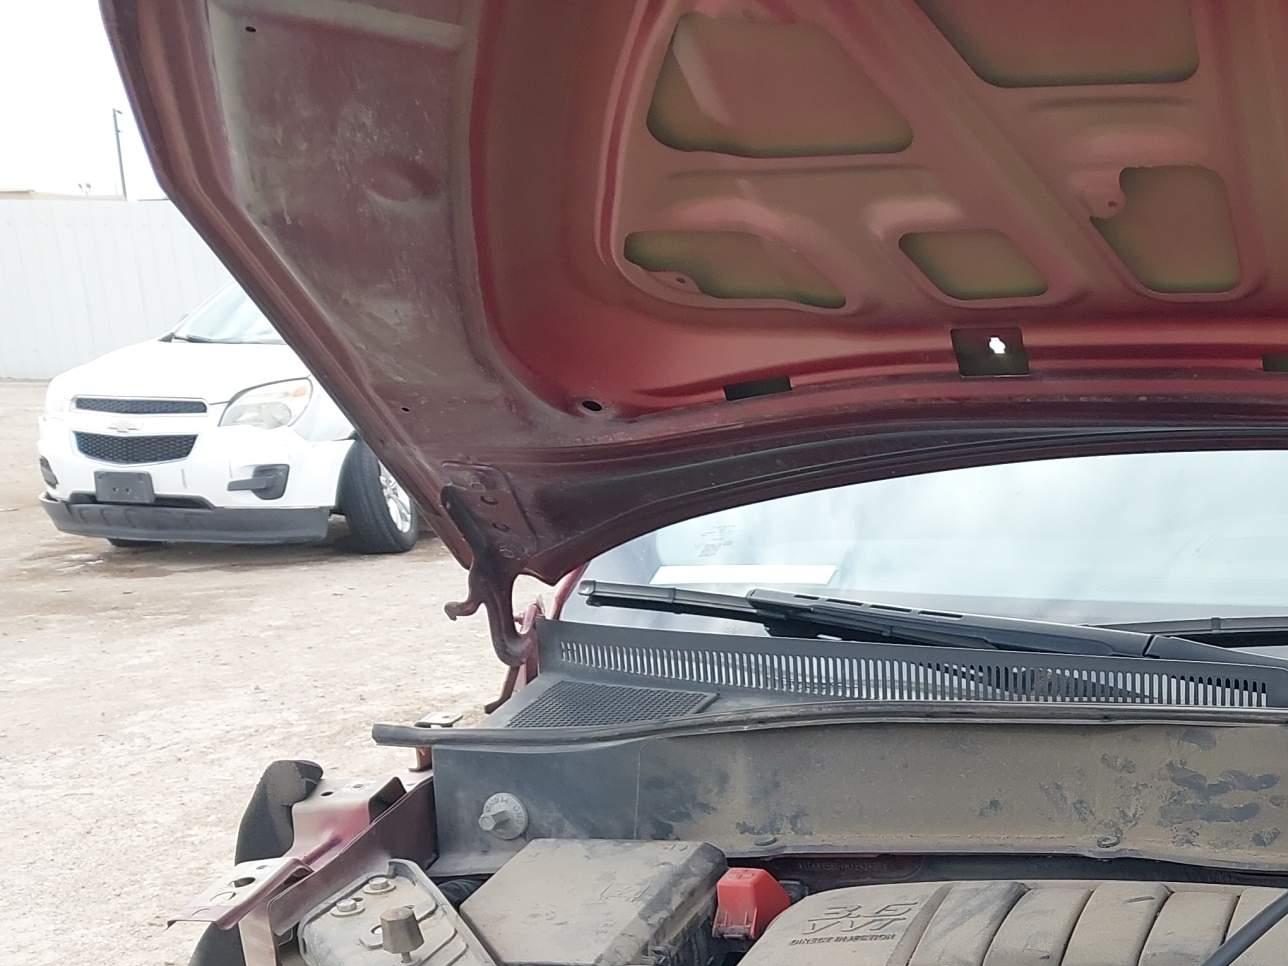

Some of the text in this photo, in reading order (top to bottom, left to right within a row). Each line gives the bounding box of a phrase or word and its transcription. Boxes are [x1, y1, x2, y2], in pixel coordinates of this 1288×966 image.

[808, 902, 918, 922] 3.6
[802, 918, 907, 935] VVT
[791, 934, 897, 945] DIRECT INJECTION
